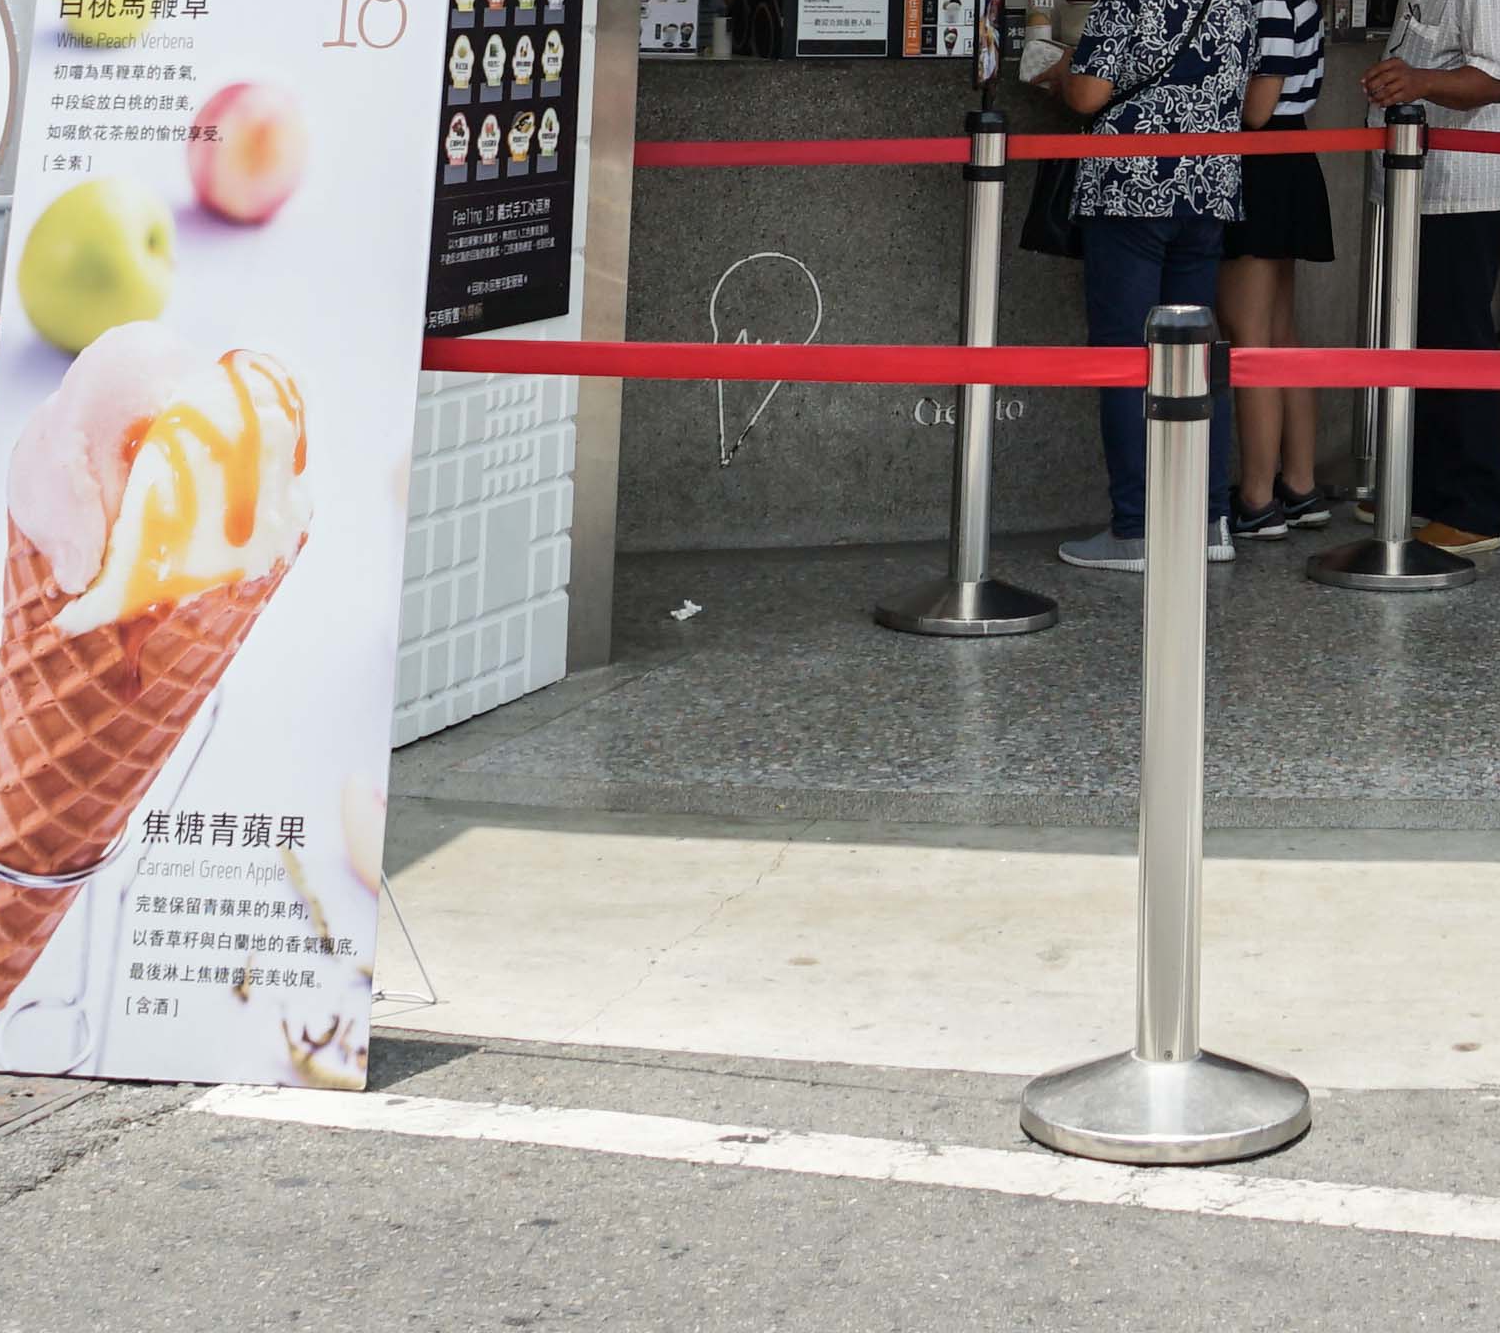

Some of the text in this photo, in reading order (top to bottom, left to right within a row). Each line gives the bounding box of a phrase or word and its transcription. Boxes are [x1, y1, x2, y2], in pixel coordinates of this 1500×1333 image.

[56, 32, 194, 49] White Peach Verbena
[51, 95, 194, 112] 中段綻放白桃的甜美,
[140, 810, 305, 849] 焦糖青蘋果
[136, 857, 286, 885] Caramel Green Apple
[135, 895, 309, 920] 完整保留青蘋果的果肉,
